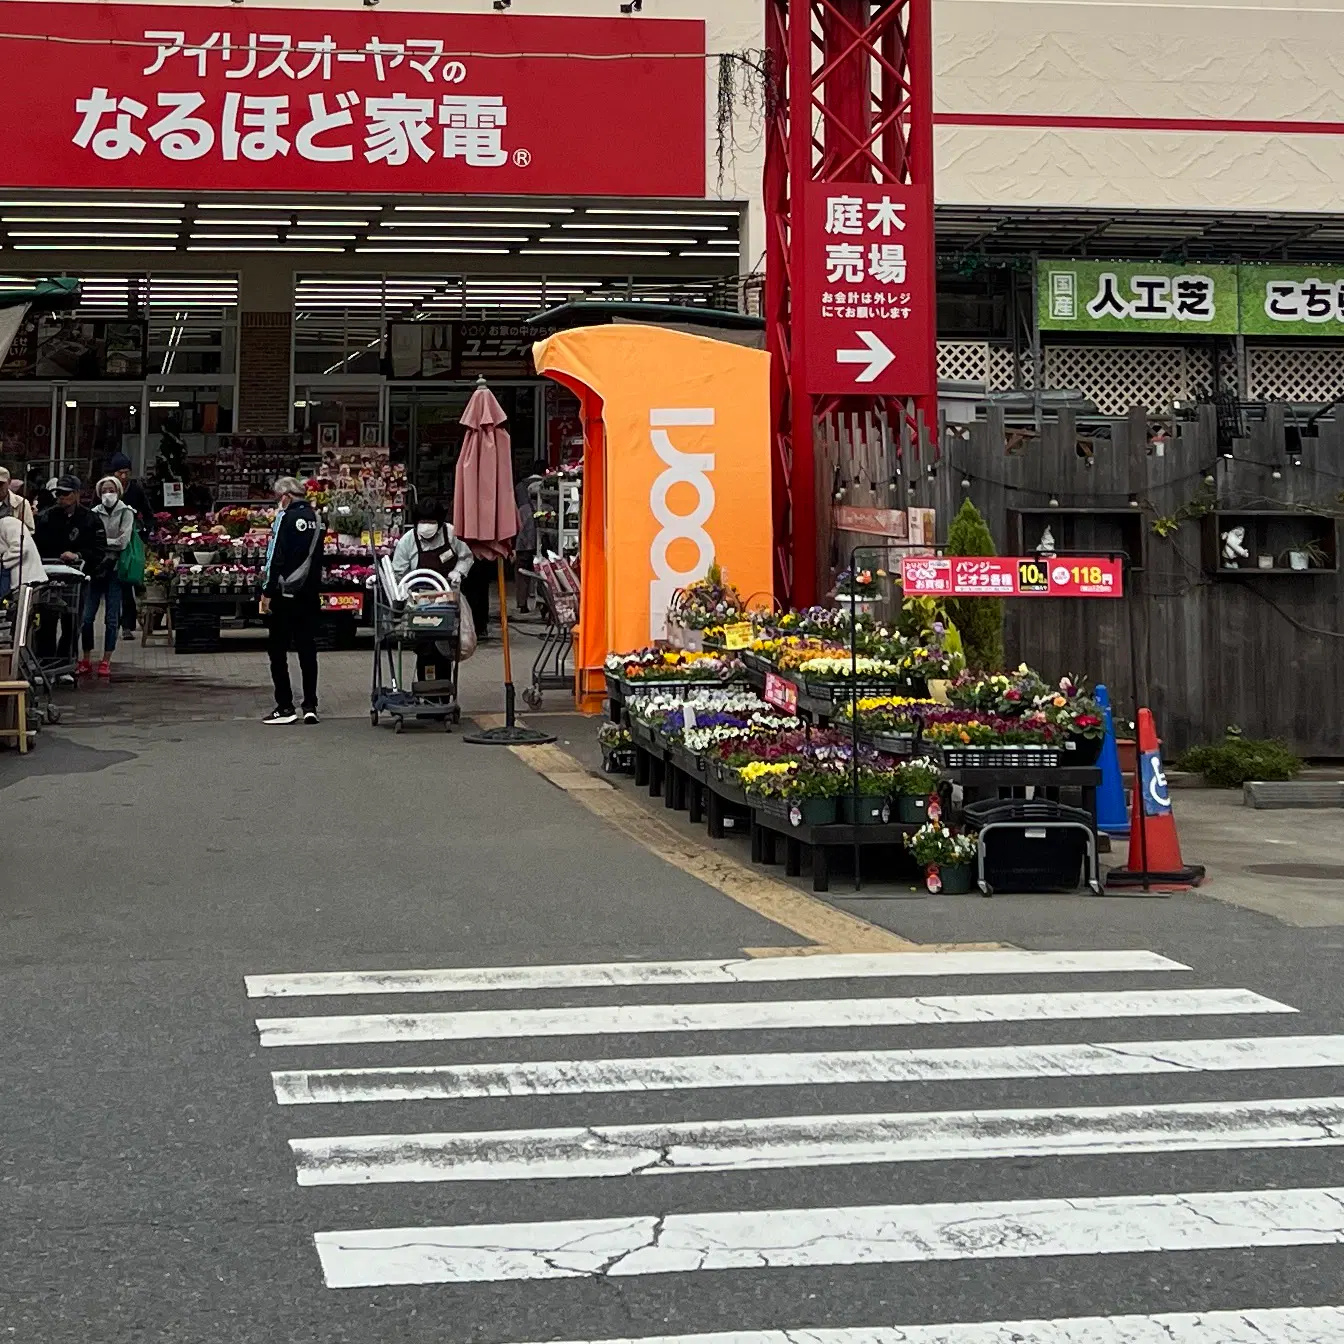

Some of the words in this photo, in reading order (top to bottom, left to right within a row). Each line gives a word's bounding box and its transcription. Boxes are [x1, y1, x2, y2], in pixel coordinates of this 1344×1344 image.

[143, 30, 467, 84] アイリスオーヤマの
[825, 194, 906, 236] 庭木
[825, 243, 907, 284] 売場
[822, 292, 911, 305] お会計は外レジ
[822, 306, 911, 319] にてお願いします
[1090, 276, 1213, 318] 人工芝
[956, 561, 1001, 574] パンジー
